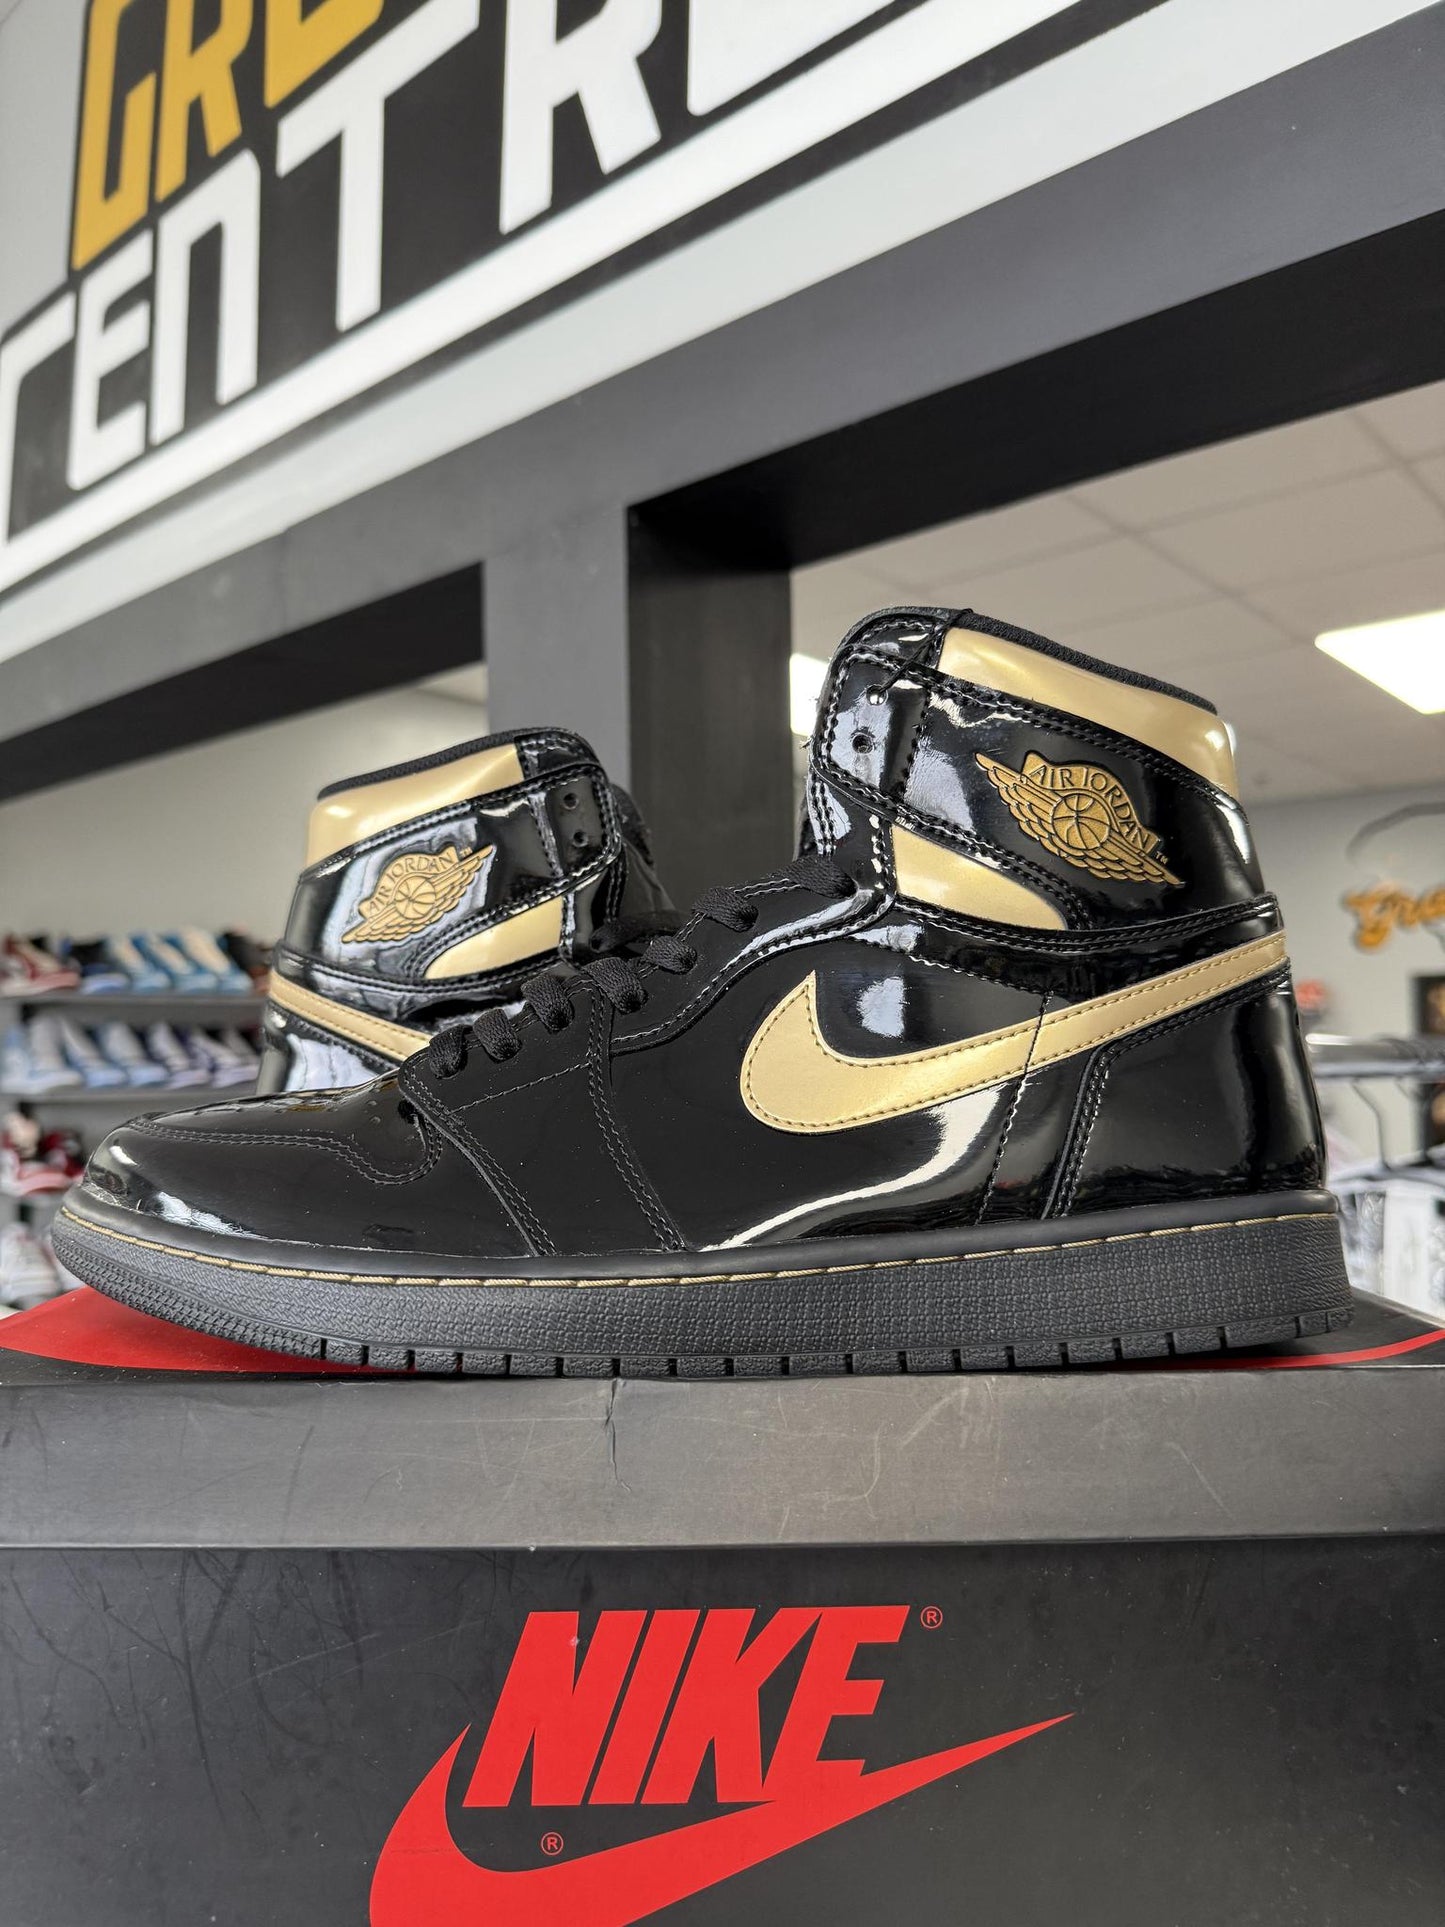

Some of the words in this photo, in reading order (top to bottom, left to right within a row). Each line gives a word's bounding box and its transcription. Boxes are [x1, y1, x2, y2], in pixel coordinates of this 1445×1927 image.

[1029, 764, 1074, 788] AIR
[1083, 767, 1148, 851] JORDAN
[369, 884, 392, 914] AIR
[387, 851, 455, 882] JORDAN
[462, 1605, 910, 1808] NIKE
